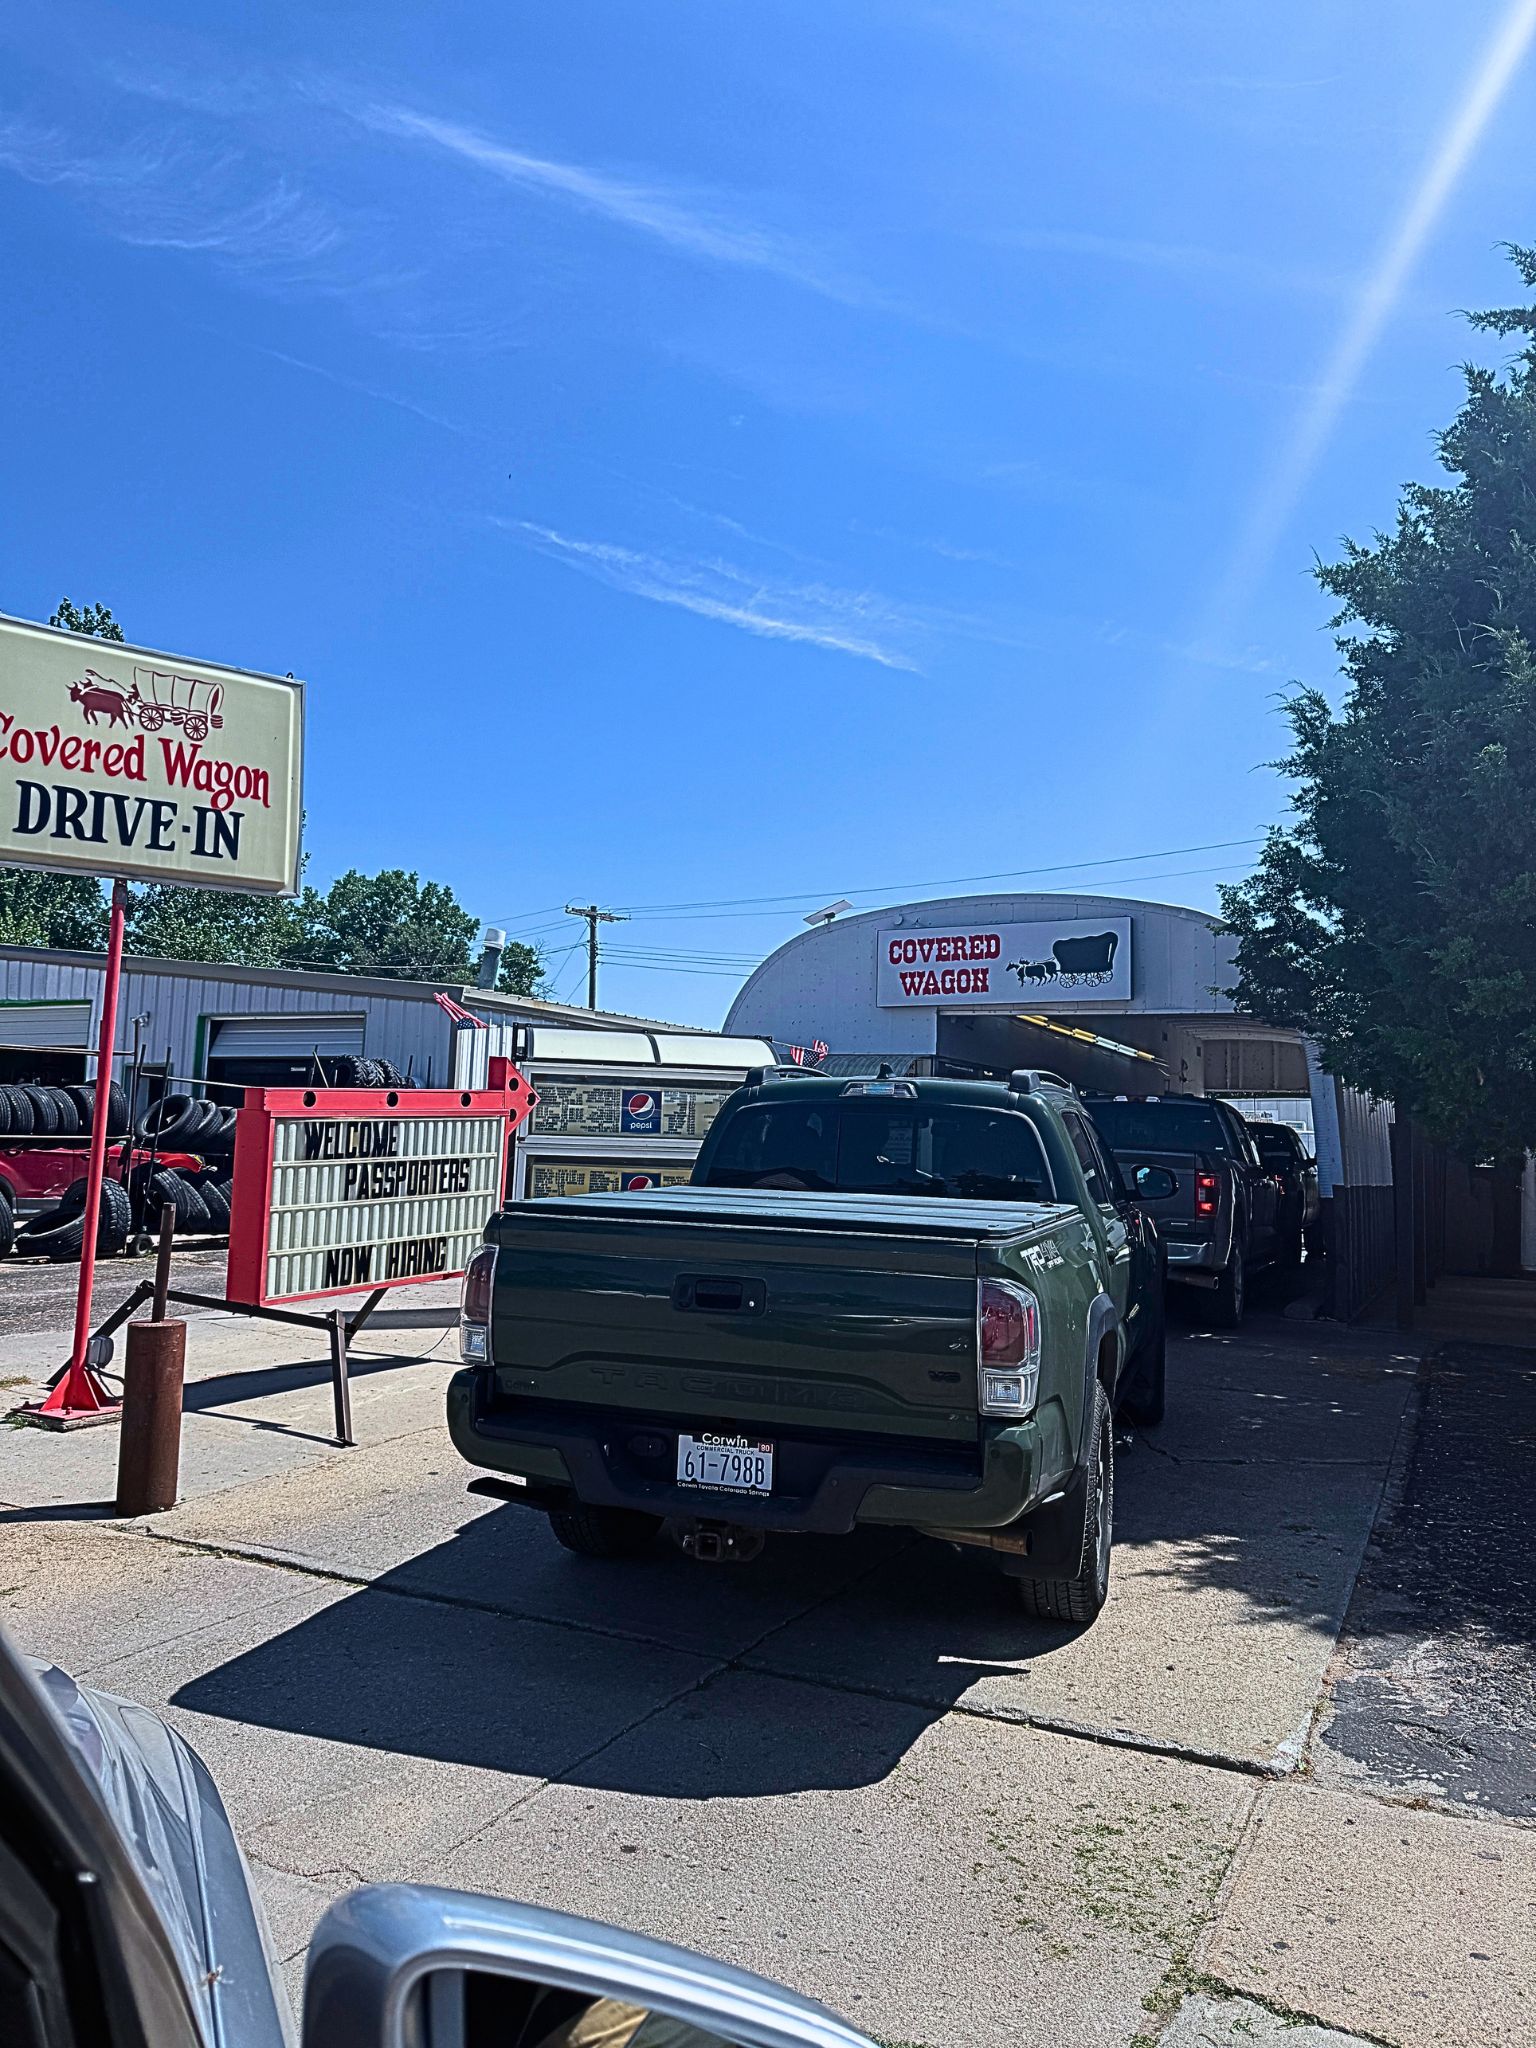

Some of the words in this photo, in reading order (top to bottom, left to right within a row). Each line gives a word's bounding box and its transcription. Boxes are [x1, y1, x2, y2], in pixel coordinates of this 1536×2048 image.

[158, 737, 271, 811] Wagon
[12, 779, 245, 861] DRIVE-IN
[888, 933, 1001, 965] COVERED
[899, 967, 990, 997] WAGON
[303, 1120, 400, 1161] WELCOME
[630, 1121, 653, 1130] pepsi
[345, 1158, 470, 1200] PASSPORTERS
[324, 1245, 373, 1289] NOW
[388, 1236, 447, 1275] HIRING
[696, 1445, 734, 1454] COMMERCIAL
[735, 1448, 755, 1456] TRUCK
[701, 1433, 748, 1447] Corwin
[684, 1450, 765, 1485] 61-798B
